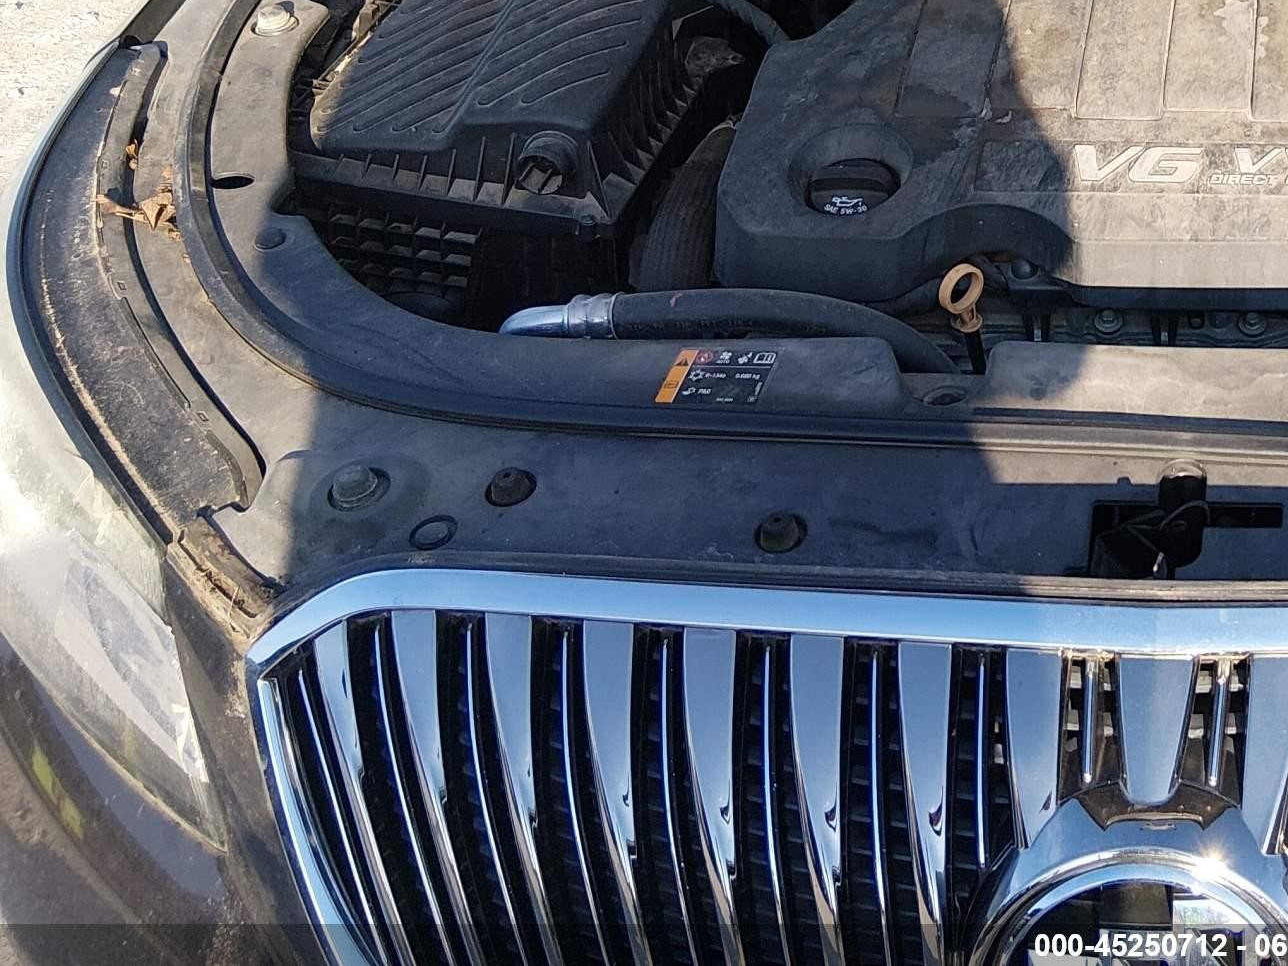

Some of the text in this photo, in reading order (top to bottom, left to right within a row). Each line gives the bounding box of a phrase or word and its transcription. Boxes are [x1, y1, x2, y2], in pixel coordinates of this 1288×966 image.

[1073, 144, 1203, 184] V6
[1210, 173, 1279, 187] DIRECT
[823, 204, 868, 215] SAE 5W-30
